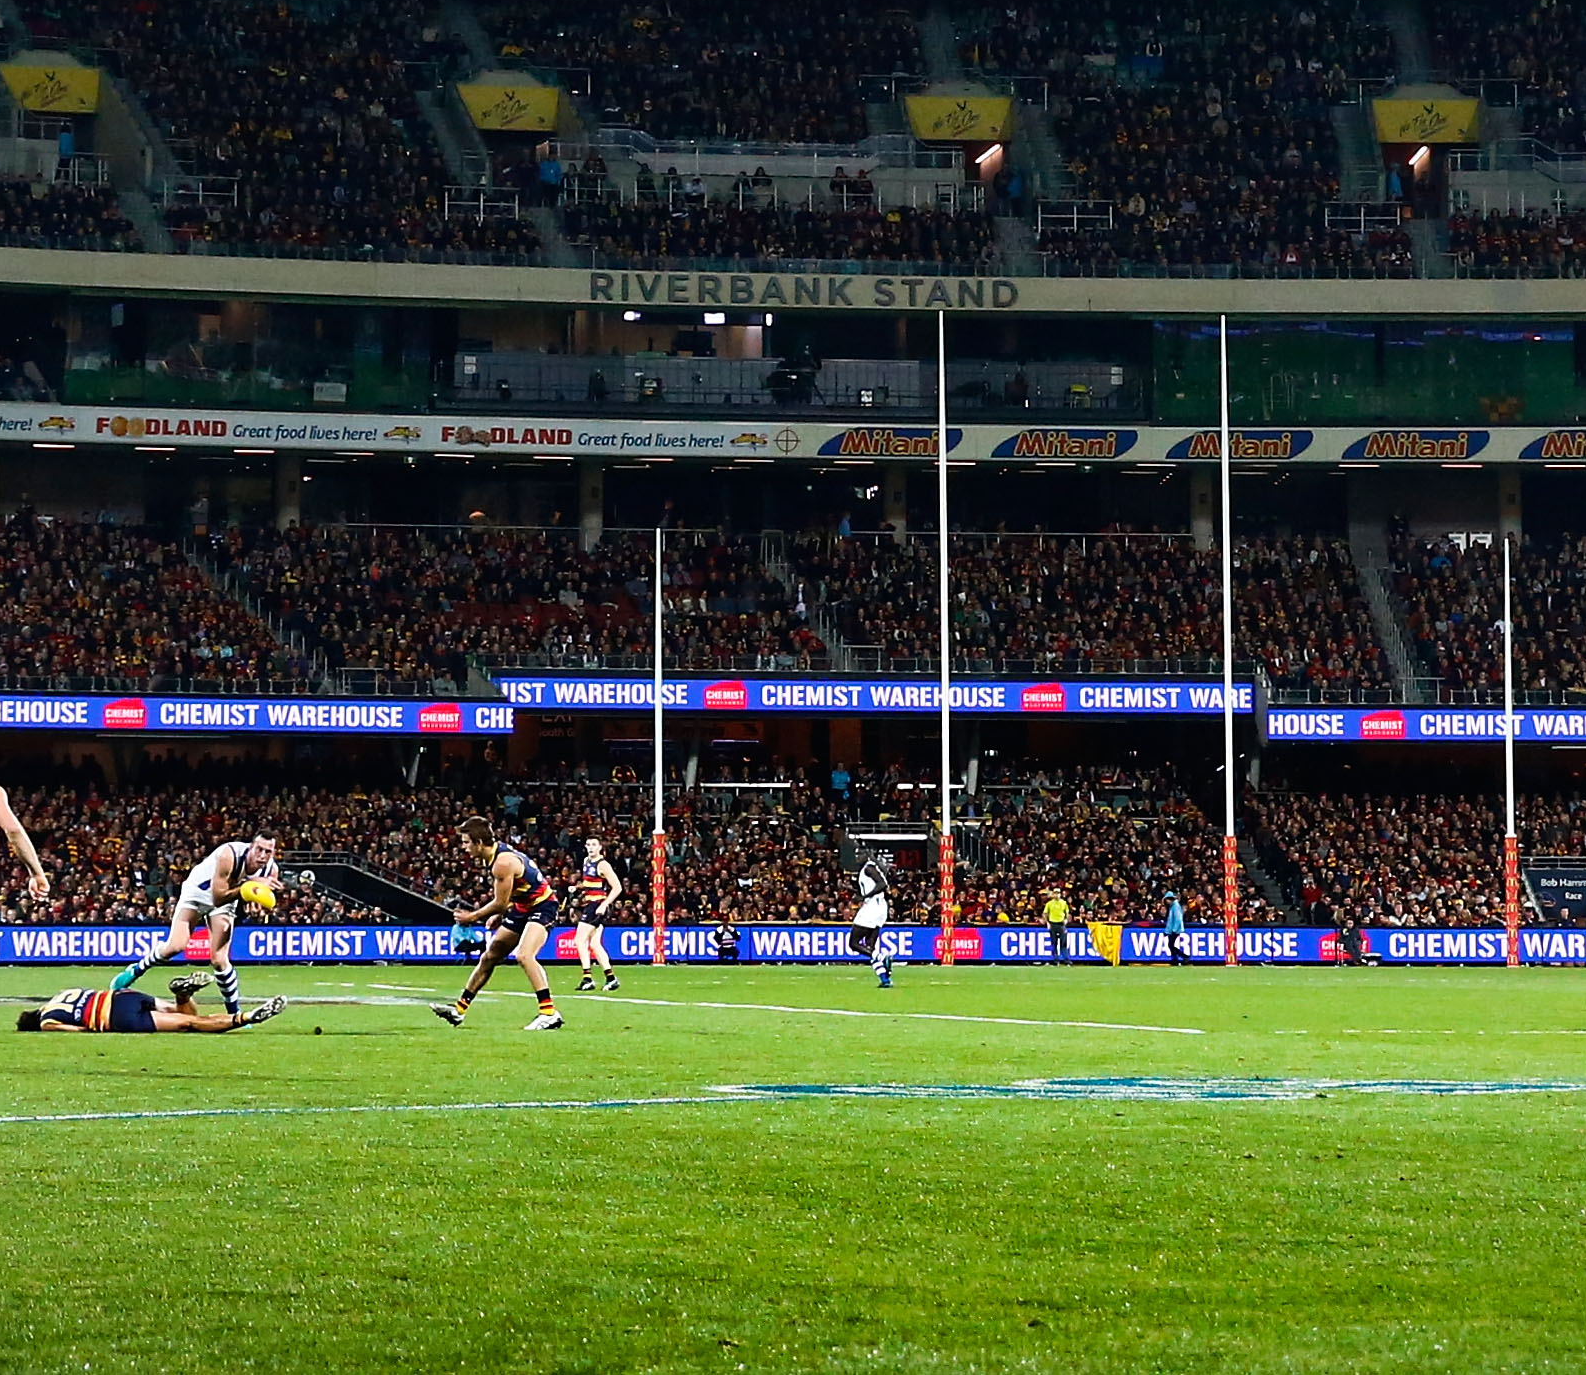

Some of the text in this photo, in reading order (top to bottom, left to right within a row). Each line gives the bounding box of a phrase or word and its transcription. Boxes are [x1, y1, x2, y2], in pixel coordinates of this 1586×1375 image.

[589, 274, 1019, 309] RIVERBANK STAND
[232, 424, 378, 442] Great food lives here!
[577, 432, 724, 450] Great food lives here!
[839, 428, 938, 456] Mitani
[1013, 430, 1116, 459] Mitani
[1188, 432, 1289, 459] Mtani
[1363, 433, 1467, 460] Mitani
[554, 683, 688, 706] WAREHOUSE
[762, 686, 861, 706] CHEMIST
[1080, 688, 1181, 707] CHEMIST
[161, 704, 402, 727] CHEMIST WAREHOUSE
[1269, 715, 1343, 734] HOUSE
[1420, 715, 1525, 736] CHEMIST
[1541, 878, 1558, 887] Bob
[1565, 892, 1583, 900] Race
[249, 931, 366, 955] CHEMIST
[620, 930, 913, 956] CHEMIS WAREHSE
[935, 937, 980, 949] CEMIST
[1389, 932, 1509, 957] CHEMIST
